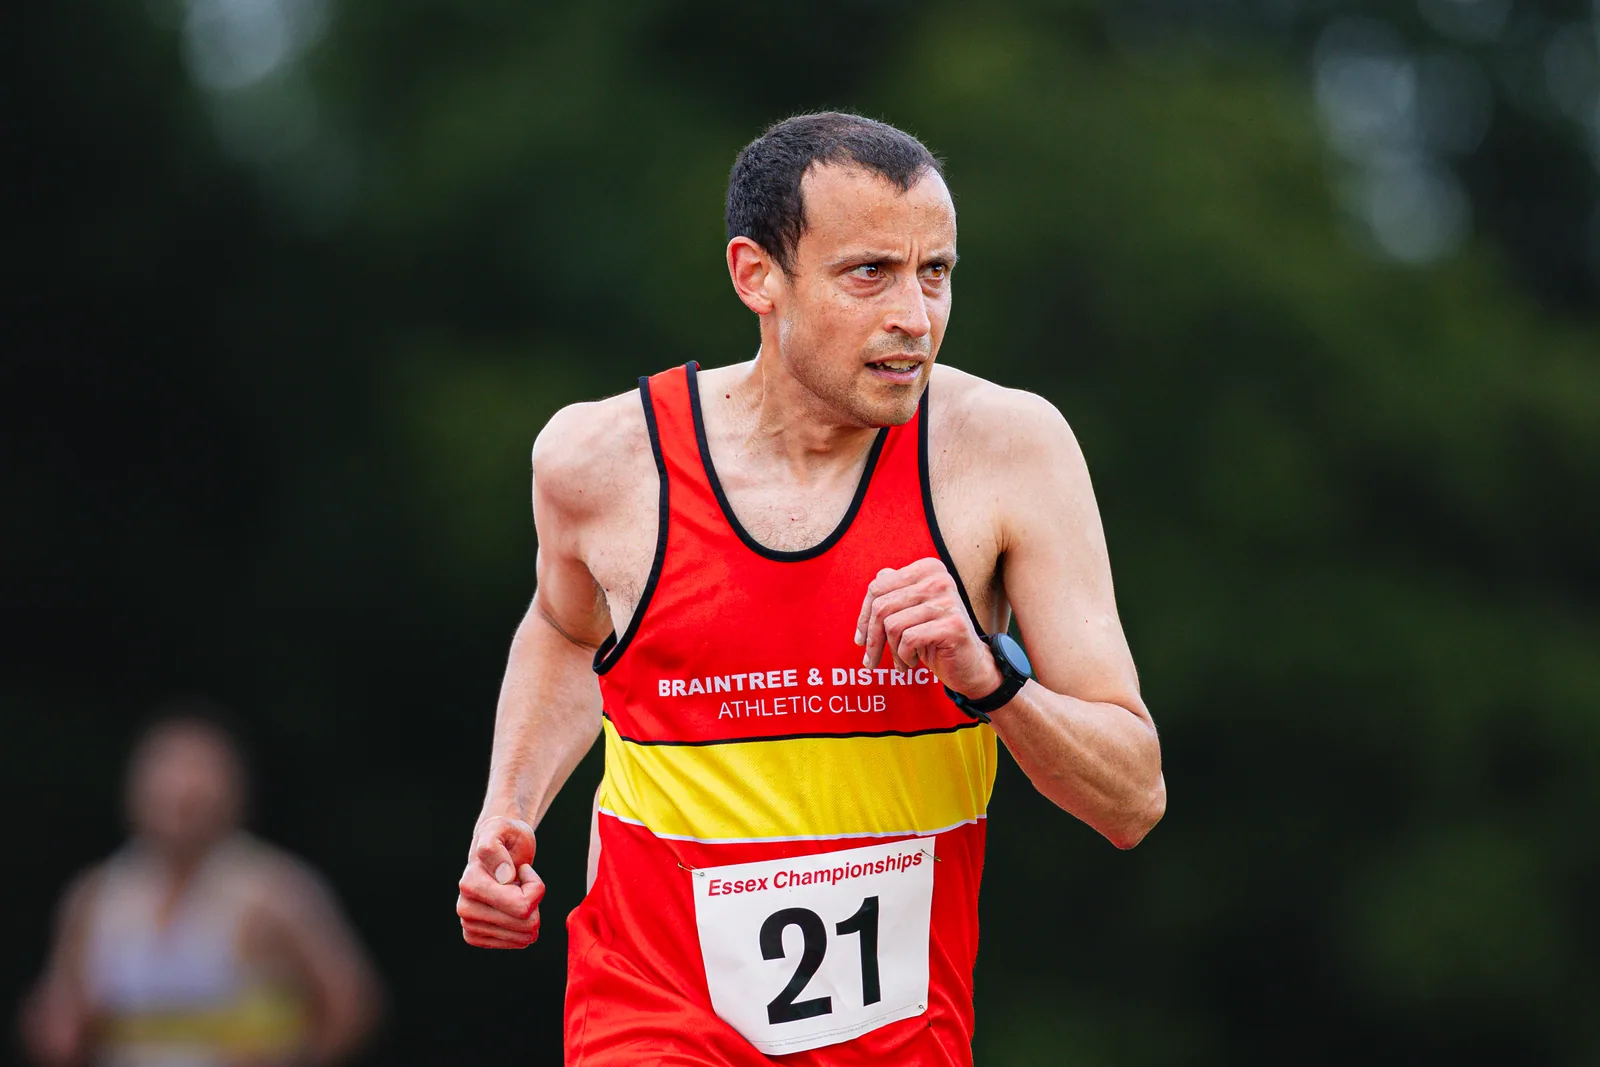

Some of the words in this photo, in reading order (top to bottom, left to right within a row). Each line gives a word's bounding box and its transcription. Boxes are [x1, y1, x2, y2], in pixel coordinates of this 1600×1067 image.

[658, 669, 798, 697] BRAINTREE
[807, 668, 824, 686] &
[718, 696, 822, 719] ATHLETIC
[829, 695, 887, 713] CLUB
[708, 877, 769, 896] Essex
[773, 851, 922, 889] Championships
[759, 895, 881, 1025] 21
